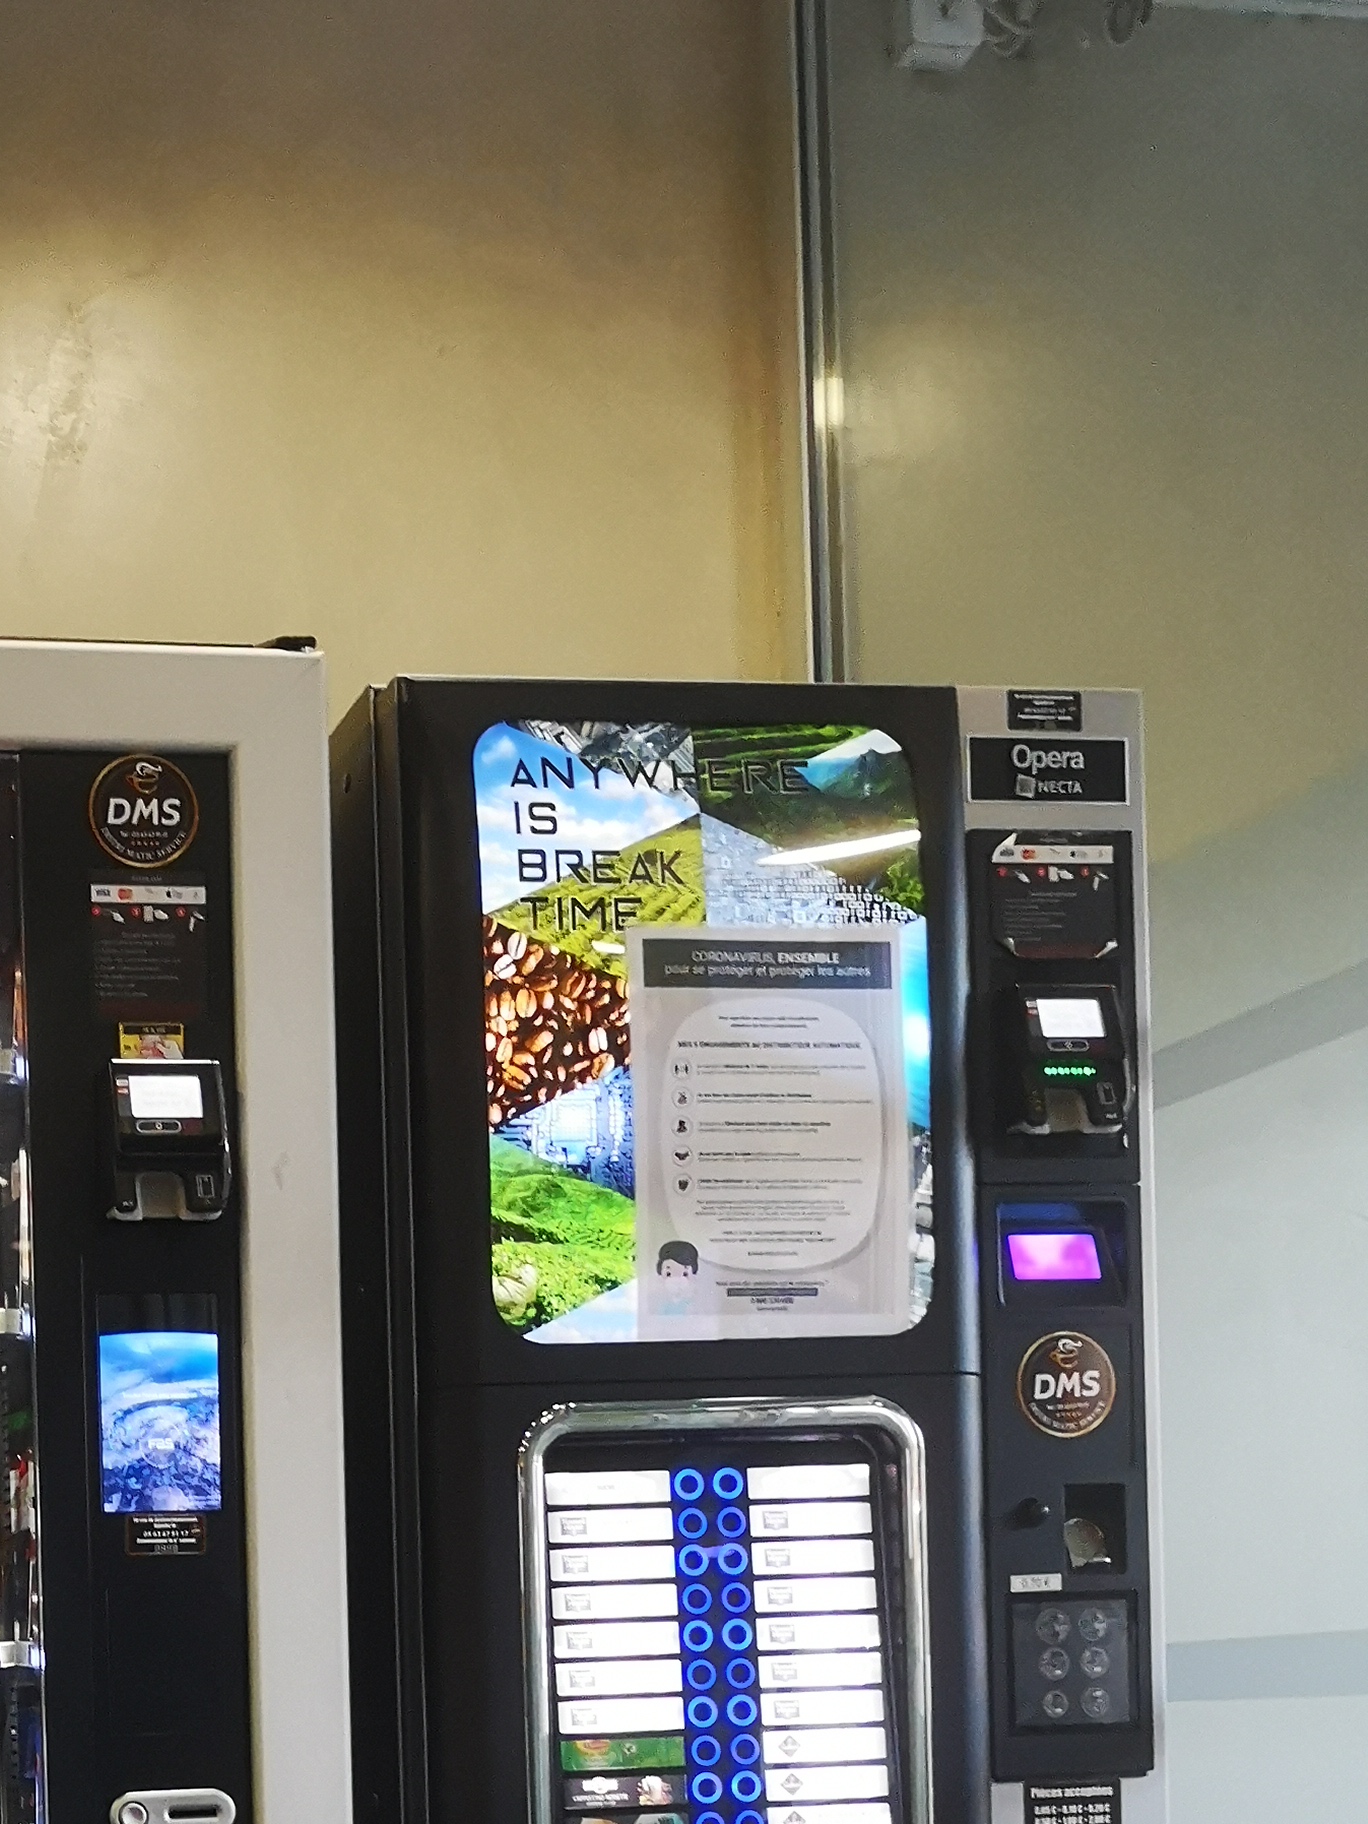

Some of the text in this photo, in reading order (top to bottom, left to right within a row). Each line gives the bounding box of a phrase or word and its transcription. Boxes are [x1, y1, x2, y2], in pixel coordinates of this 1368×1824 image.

[510, 756, 810, 795] ANYWHERE
[1012, 744, 1085, 775] Opera
[1037, 781, 1083, 794] NECTA
[107, 798, 182, 826] DMS
[513, 801, 558, 835] IS
[518, 848, 684, 886] BREAK
[520, 896, 643, 932] TIME
[1033, 1370, 1101, 1400] DMS
